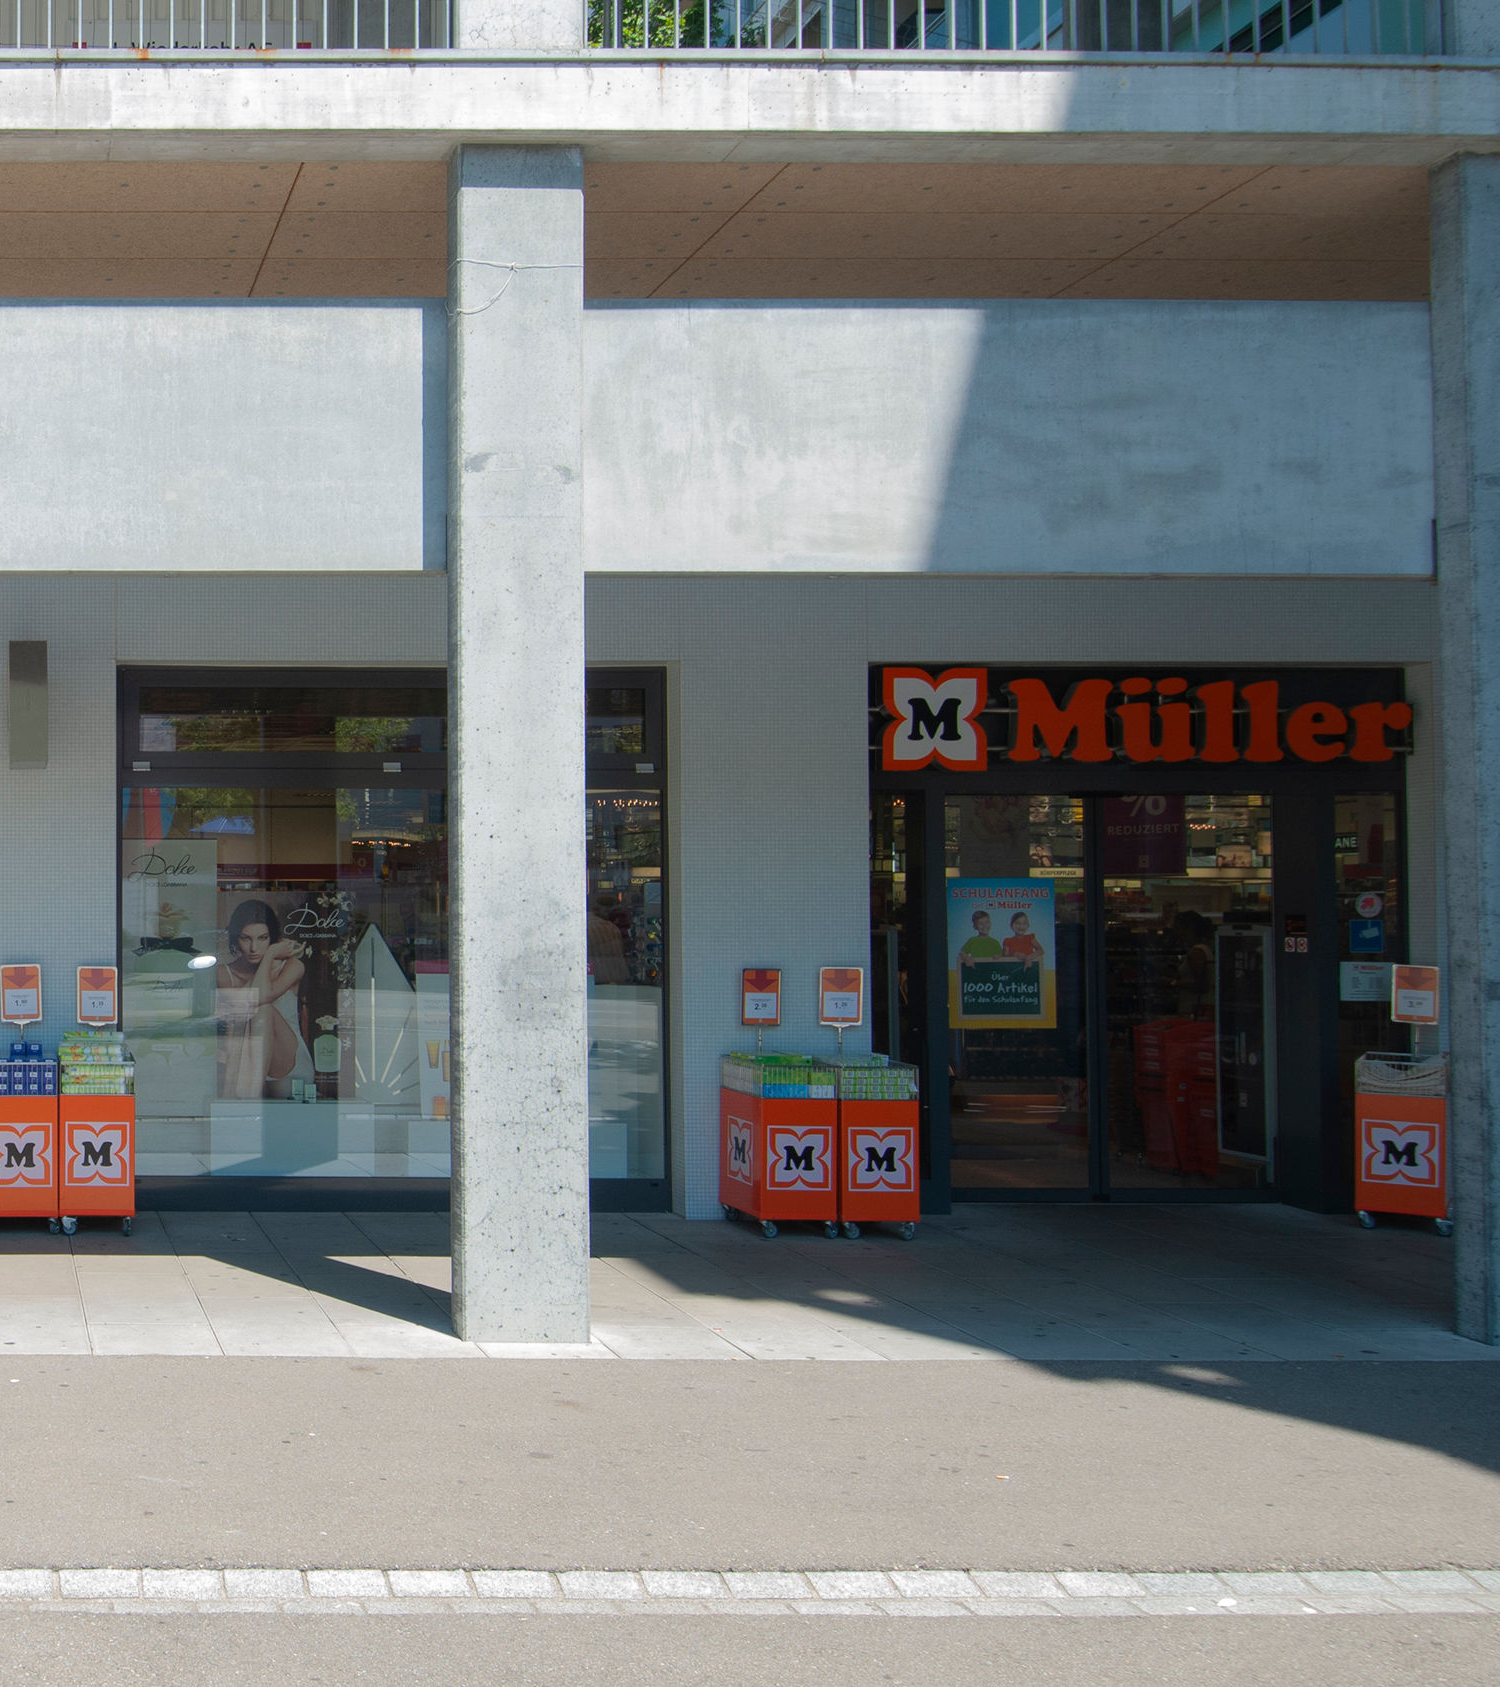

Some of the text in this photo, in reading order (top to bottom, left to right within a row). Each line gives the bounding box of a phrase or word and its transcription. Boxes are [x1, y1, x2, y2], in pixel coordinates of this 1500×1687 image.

[908, 677, 1412, 762] M Müller
[1107, 823, 1179, 836] REDUZIERT
[127, 847, 196, 881] Dolce
[952, 888, 1049, 899] SCHULANFANG
[998, 901, 1033, 909] Müller
[284, 902, 345, 936] Dolce
[964, 982, 1038, 993] 1000 Artikel
[991, 971, 1009, 981] Über
[964, 995, 975, 1003] für
[993, 995, 1038, 1005] Schulanfang
[5, 1143, 35, 1167] M
[82, 1142, 112, 1166] M
[734, 1137, 747, 1163] M
[784, 1146, 815, 1171] M
[866, 1147, 897, 1172] M
[1382, 1140, 1419, 1167] M
